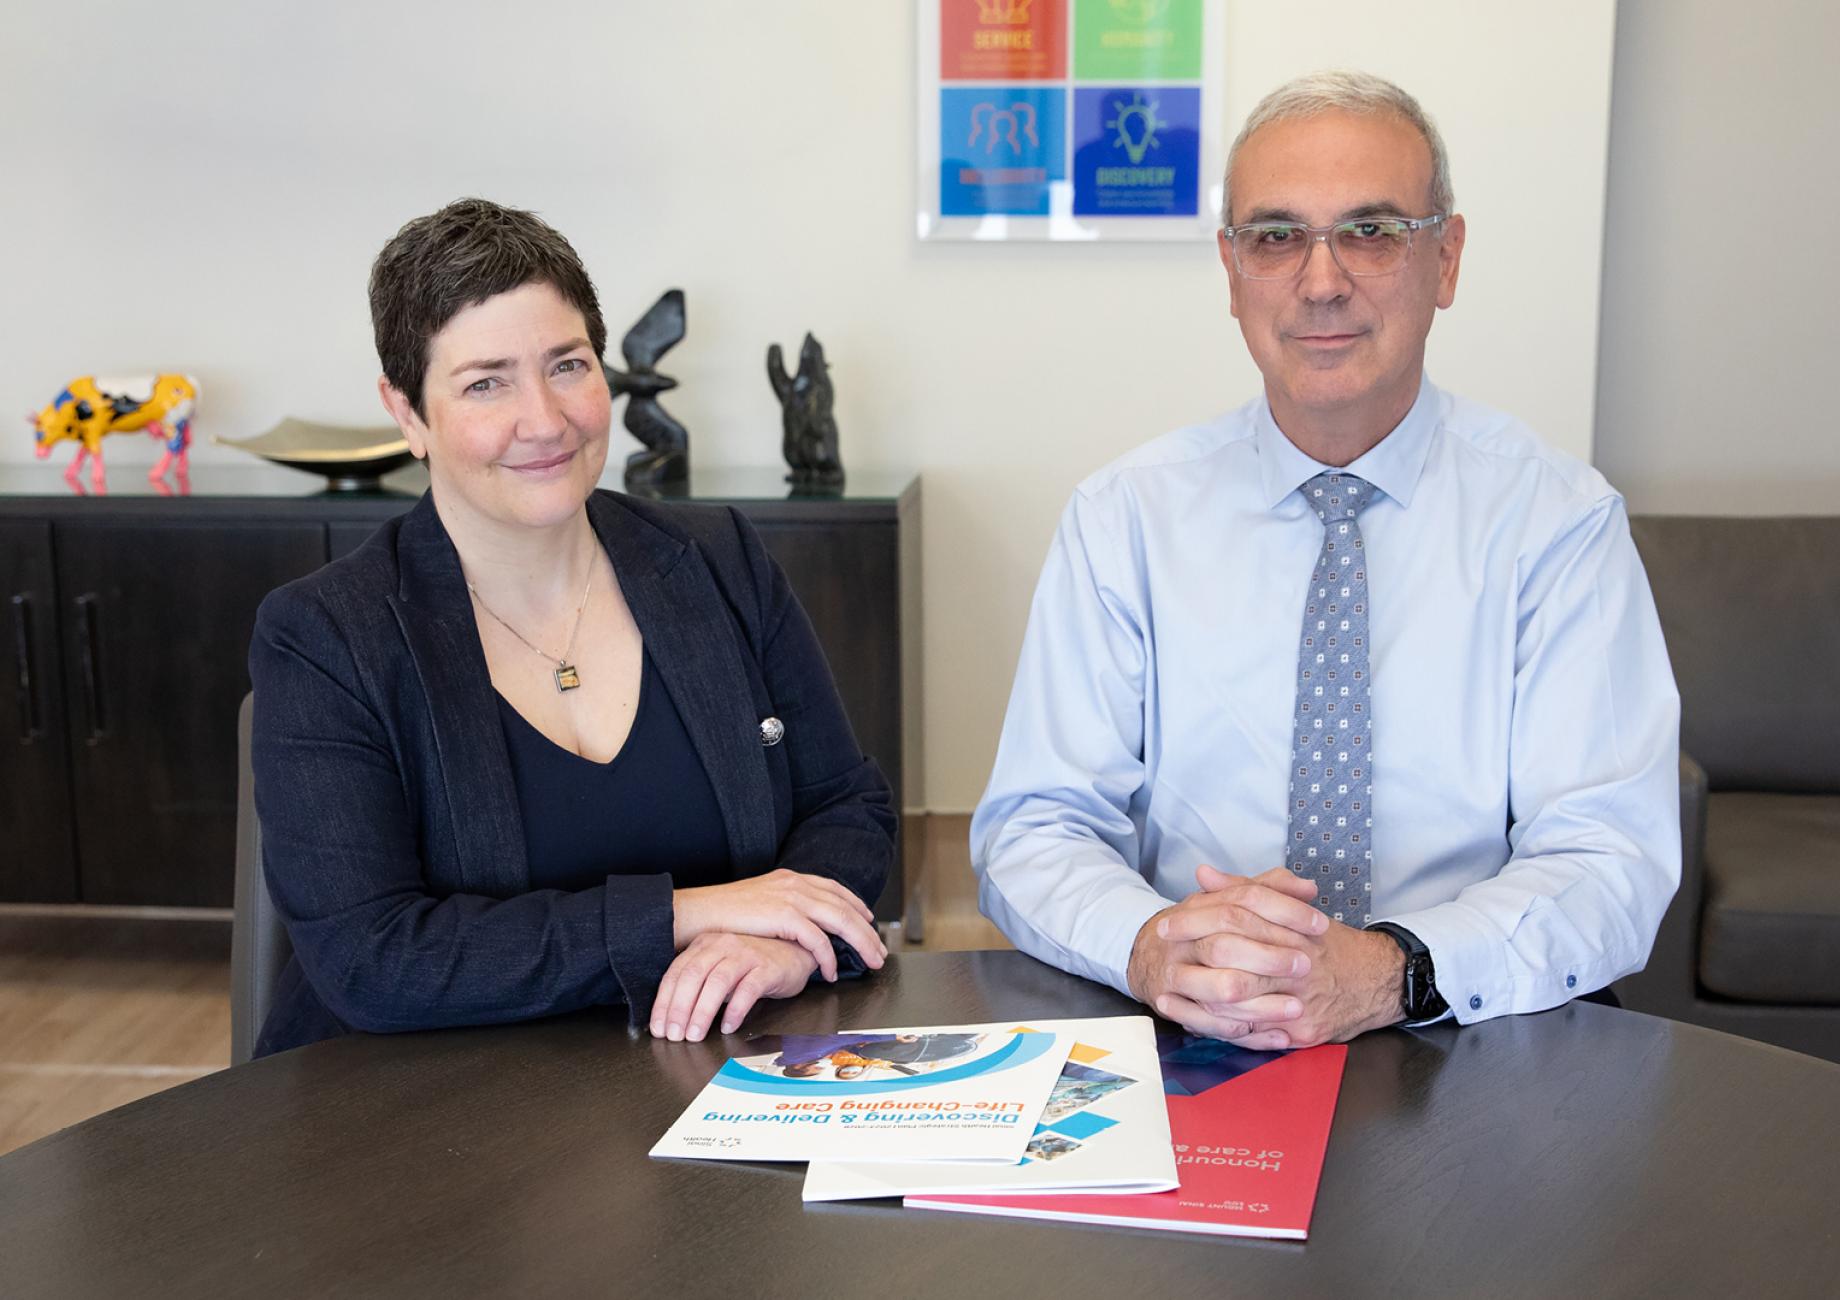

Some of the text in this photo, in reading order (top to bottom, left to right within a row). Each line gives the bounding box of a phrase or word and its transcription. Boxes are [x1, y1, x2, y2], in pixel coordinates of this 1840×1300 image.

[973, 30, 1033, 49] SERVICE
[1096, 167, 1176, 185] DISCOVERY
[775, 1100, 1025, 1112] Life-Changing Care
[702, 1112, 1019, 1124] Discovering & Delivering
[1196, 1145, 1251, 1156] care
[1256, 1150, 1285, 1159] of
